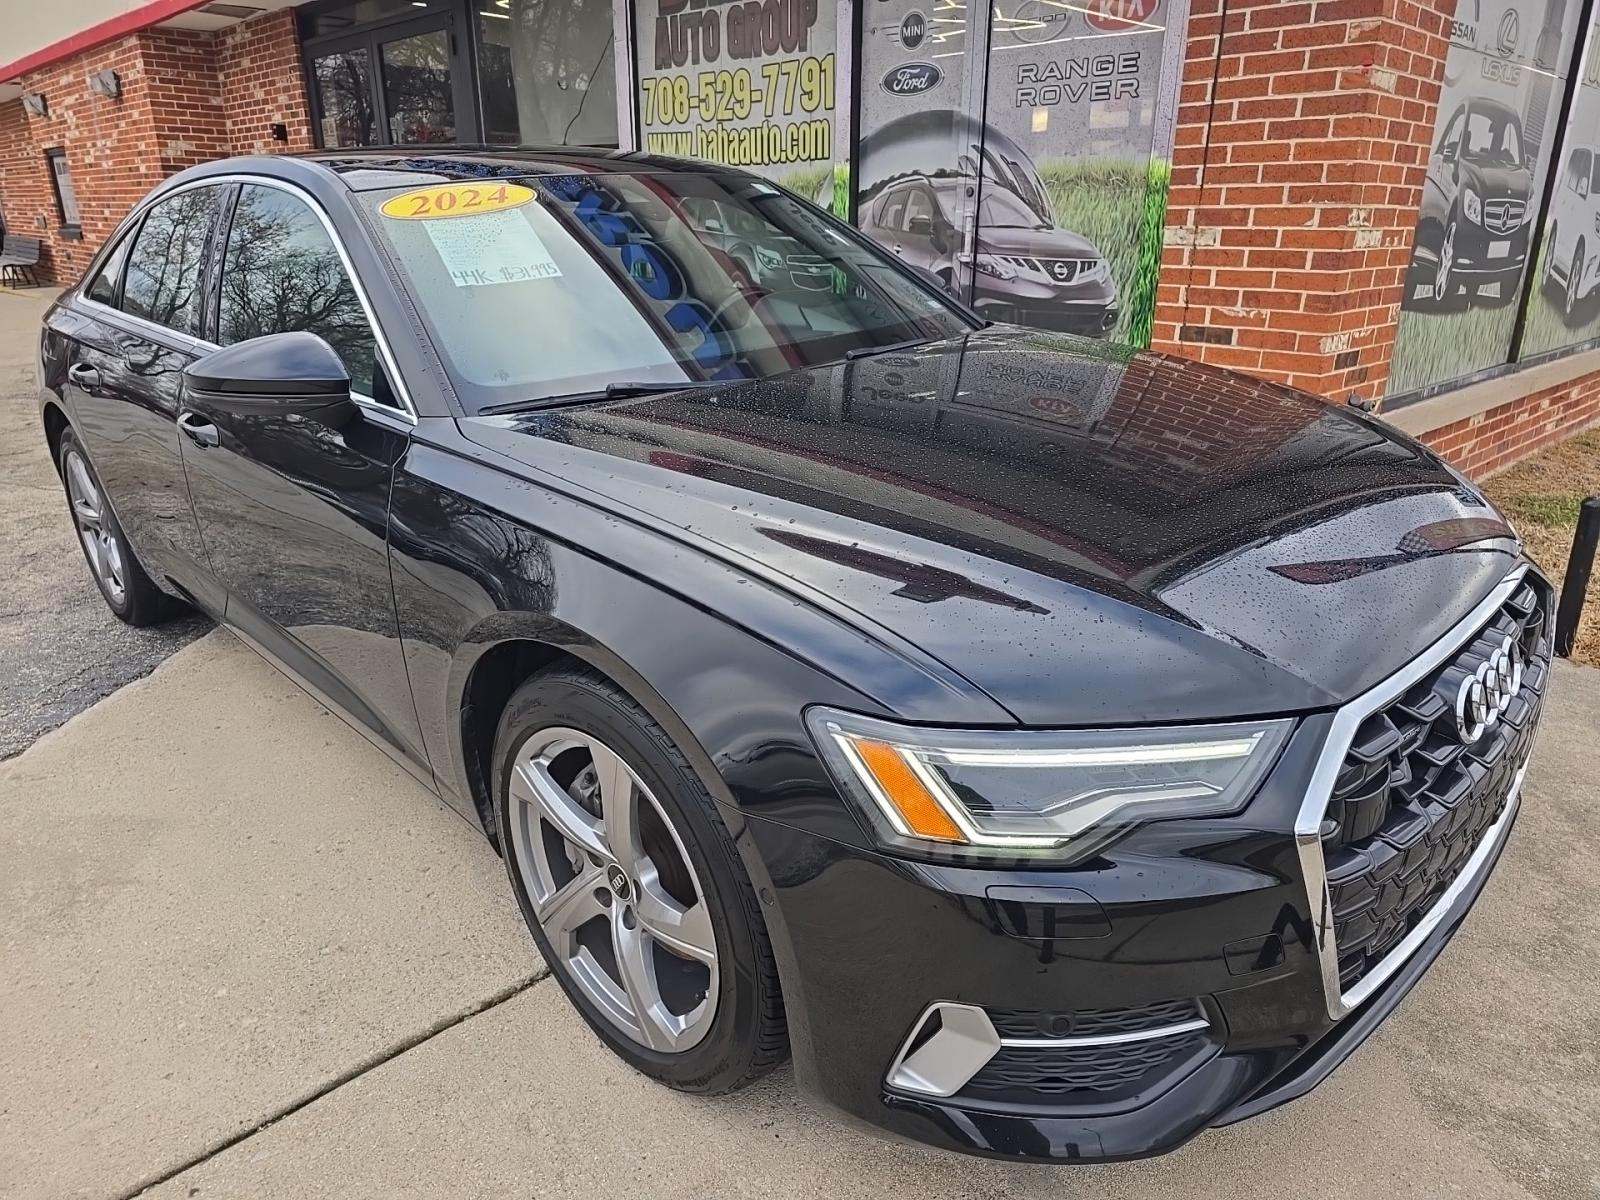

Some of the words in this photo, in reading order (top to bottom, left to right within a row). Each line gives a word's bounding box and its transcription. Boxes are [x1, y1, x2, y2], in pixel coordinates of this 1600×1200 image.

[1098, 0, 1144, 22] KIA
[655, 9, 720, 70] AUTO
[727, 0, 818, 60] GROUP
[903, 24, 924, 38] MINI
[1450, 20, 1477, 43] SSAN
[893, 68, 929, 91] Ford
[1017, 51, 1141, 84] RANGE
[642, 53, 835, 126] 708-529-7791
[1015, 78, 1140, 108] ROVER
[409, 186, 509, 216] 2024
[452, 268, 495, 285] 44K
